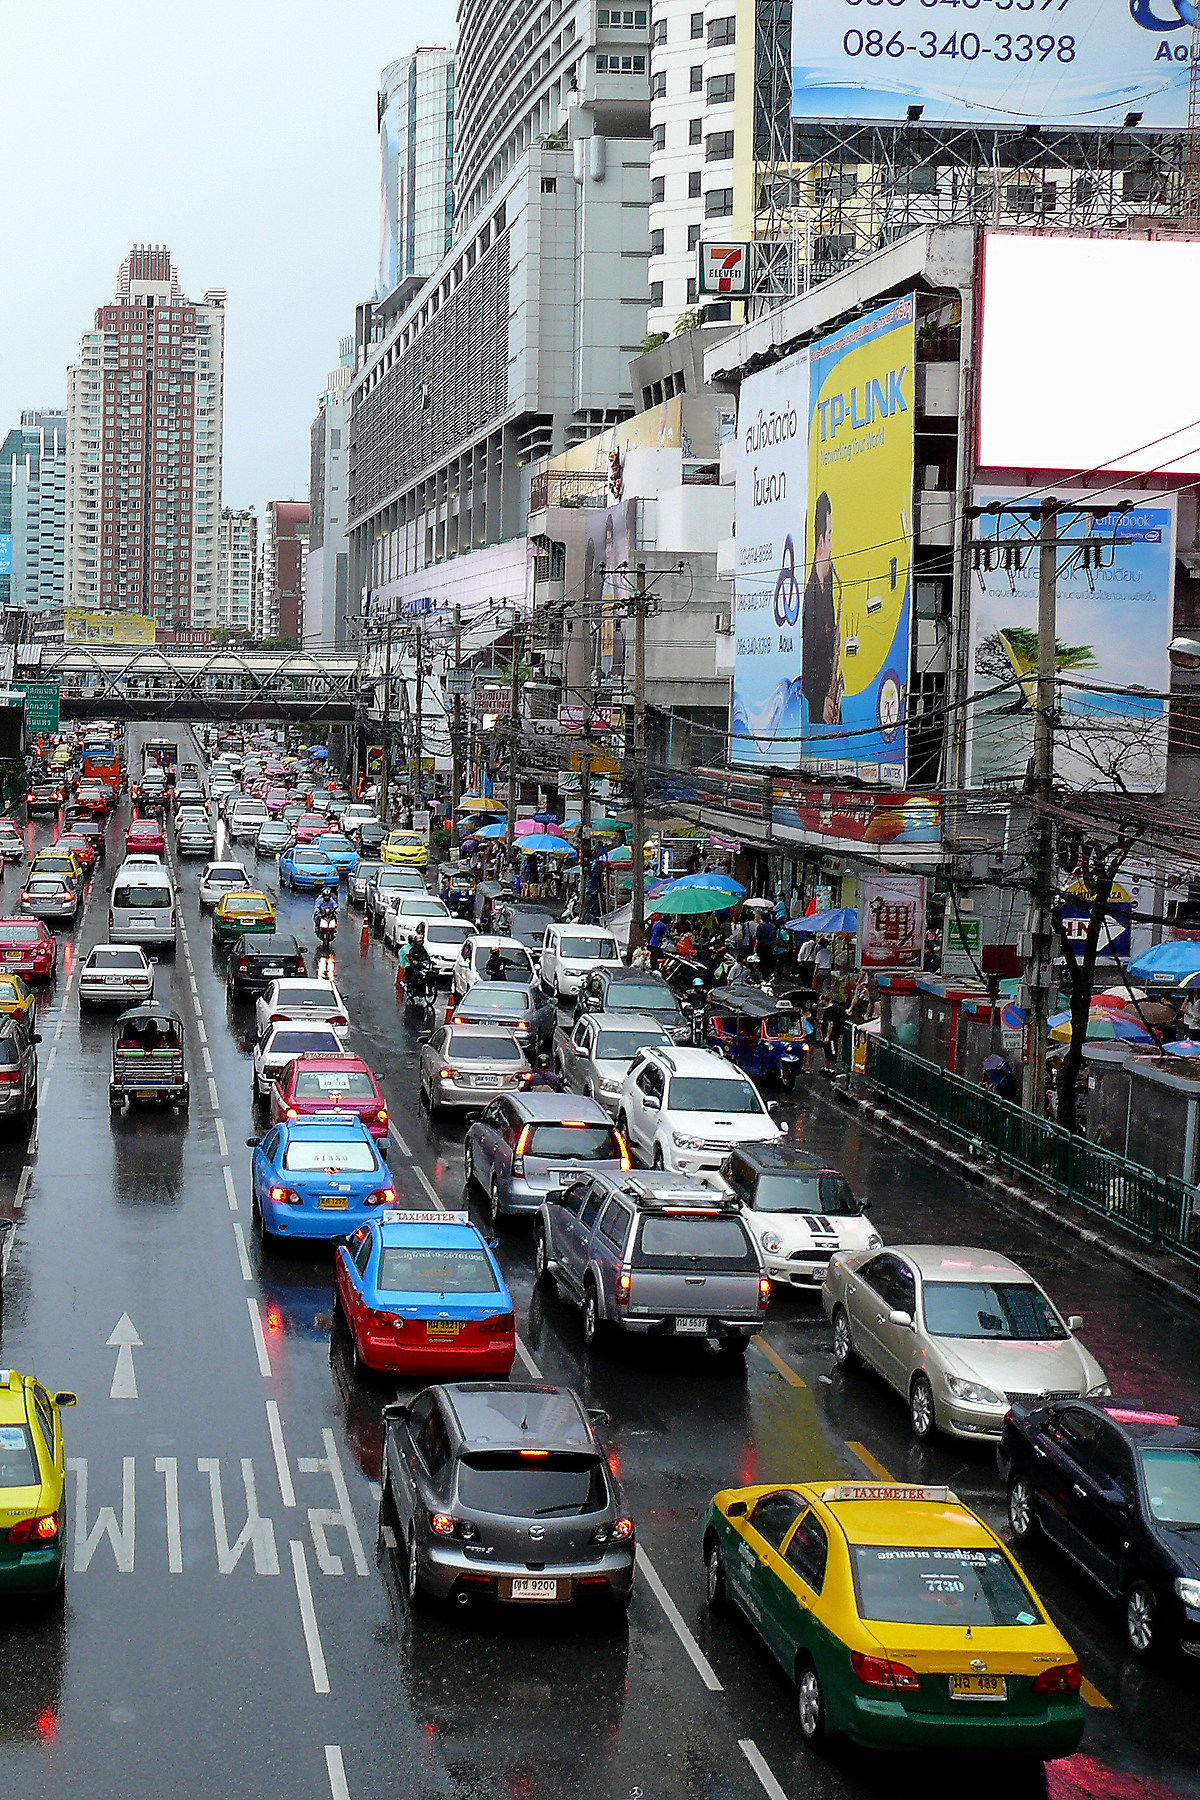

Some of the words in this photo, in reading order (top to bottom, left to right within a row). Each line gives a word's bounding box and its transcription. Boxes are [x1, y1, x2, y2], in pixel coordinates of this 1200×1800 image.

[843, 30, 1077, 64] 086-340-3398
[817, 364, 909, 443] TP-LINK
[745, 400, 797, 455] สนใจติดต่อ
[753, 466, 786, 507] โฆษณา
[852, 1487, 925, 1500] TAXI-METER
[531, 1580, 555, 1590] 9200
[925, 1580, 964, 1592] 7730
